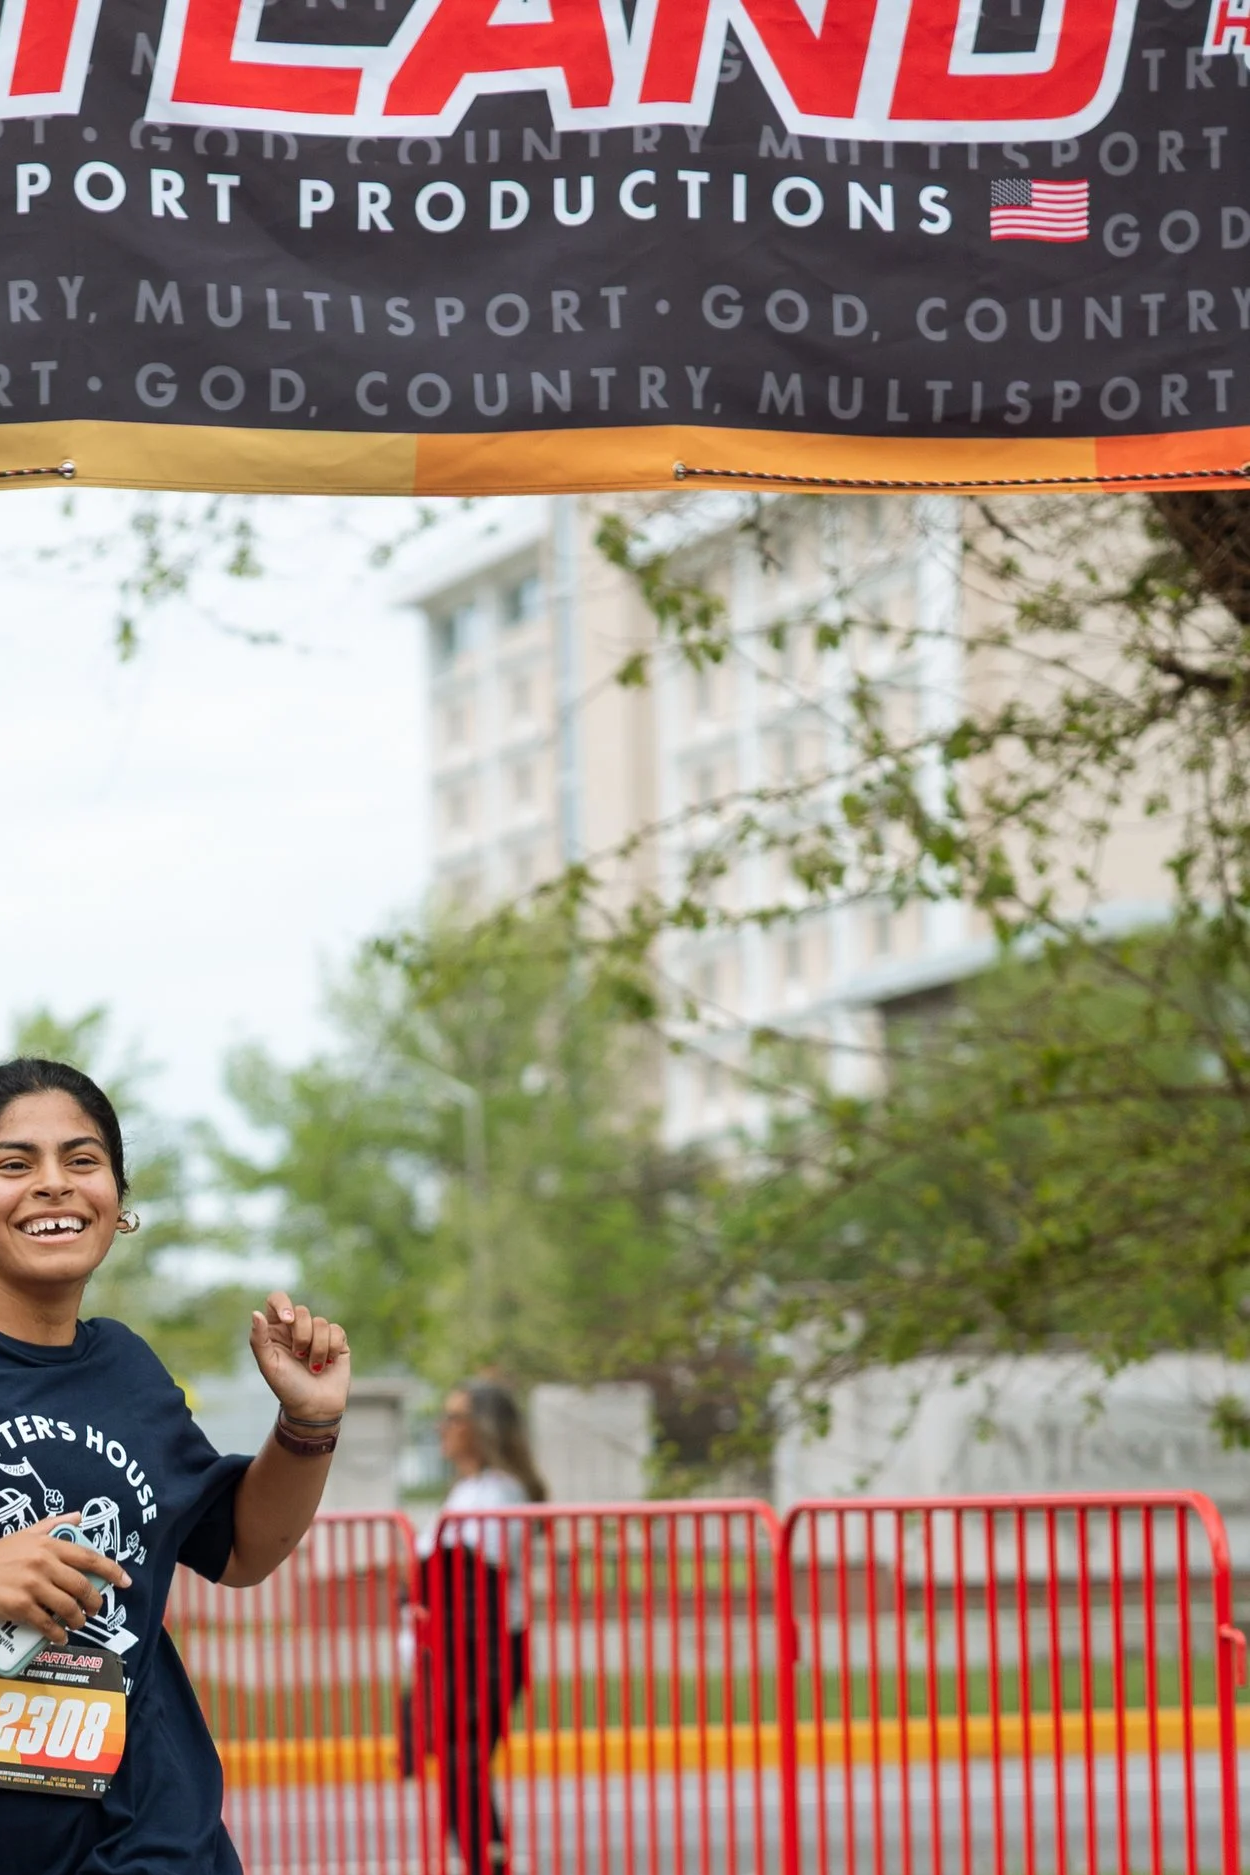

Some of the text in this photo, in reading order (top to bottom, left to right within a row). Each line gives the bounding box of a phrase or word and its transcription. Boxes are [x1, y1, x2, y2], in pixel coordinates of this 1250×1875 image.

[299, 169, 952, 235] PRODUCTIONS
[135, 279, 627, 337] MULTISPORT
[701, 284, 881, 343] GOD,
[135, 362, 318, 418] GOD,
[356, 365, 723, 418] COUNTRY,
[757, 370, 1235, 425] MULTISPORT
[86, 1425, 157, 1525] HOUSE
